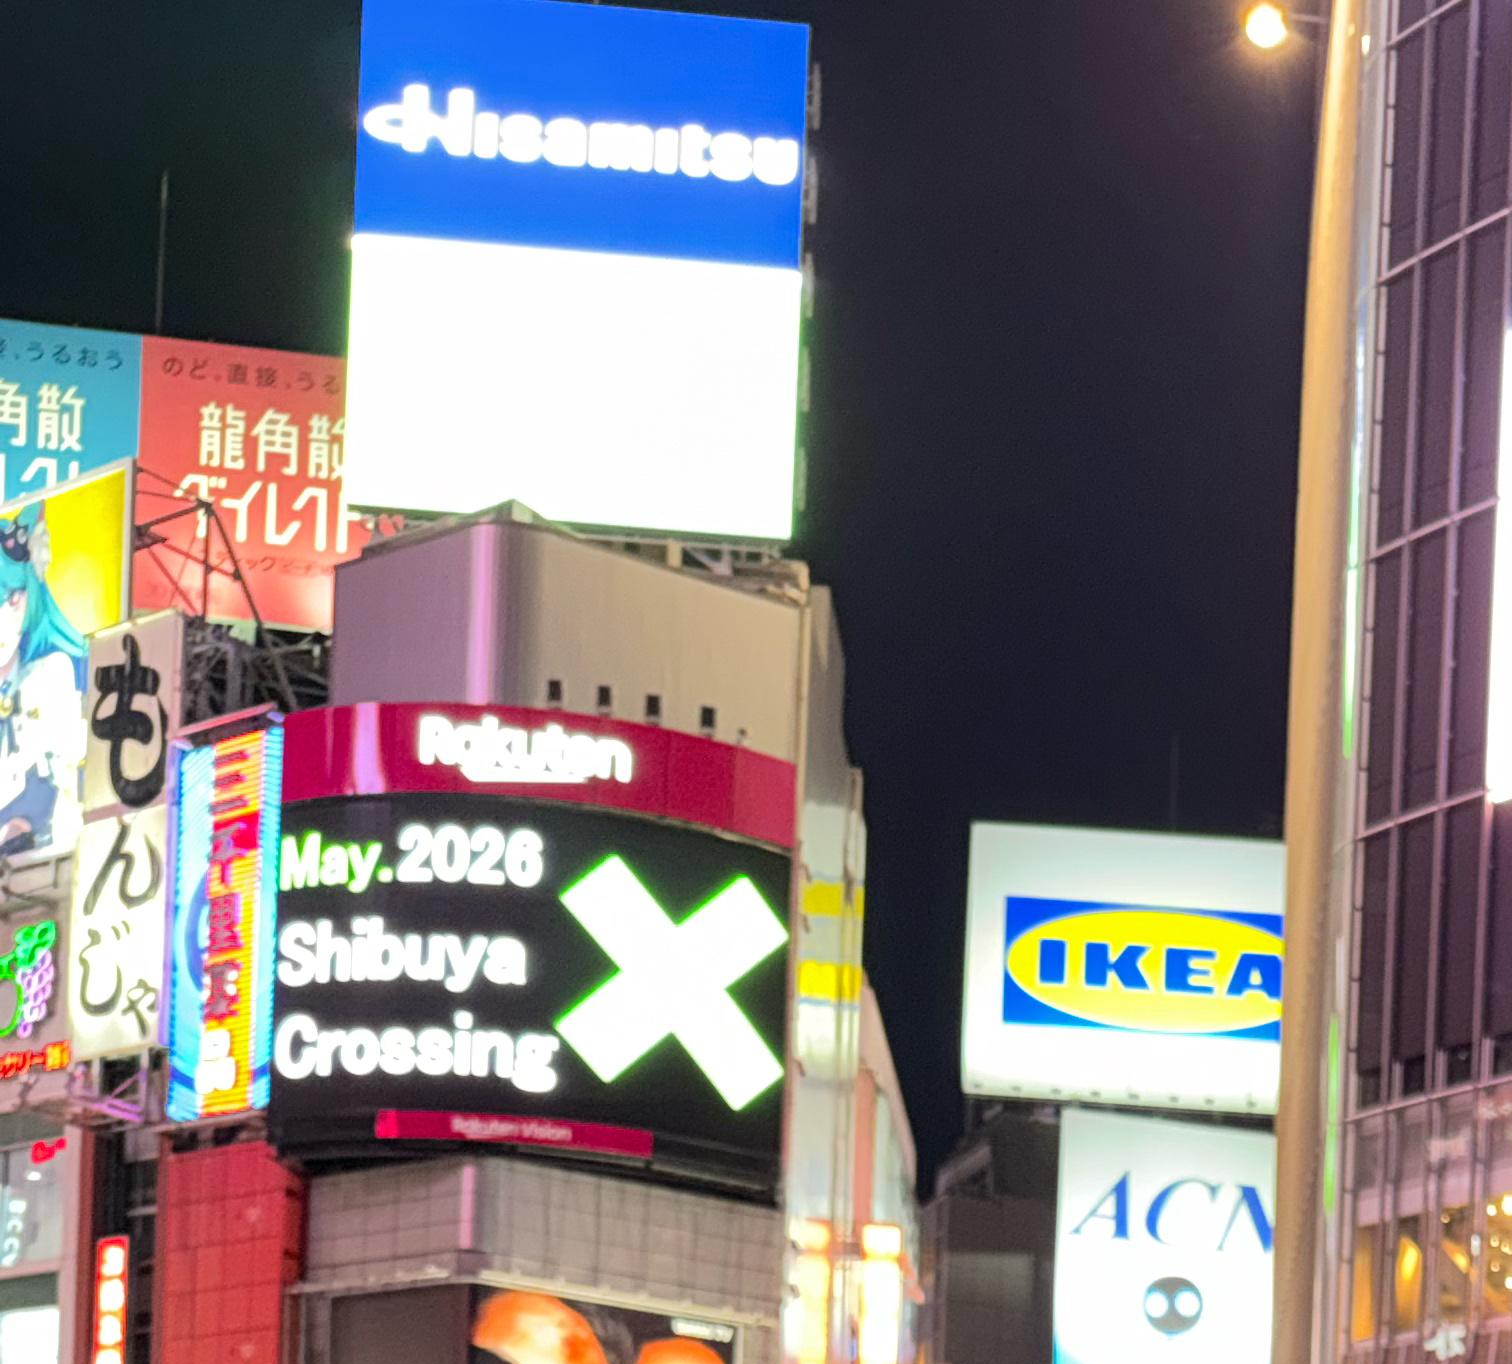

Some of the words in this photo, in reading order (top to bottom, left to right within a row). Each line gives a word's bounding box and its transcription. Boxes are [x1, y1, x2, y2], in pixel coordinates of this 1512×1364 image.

[363, 84, 798, 185] Hisamitsu
[0, 339, 124, 371] 、うるおう
[199, 401, 346, 480] 龍角散
[174, 474, 361, 553] ダイレクト
[418, 715, 633, 783] Rakuten
[79, 634, 168, 1038] もんじゃ
[277, 915, 528, 992] Shibuya
[1038, 937, 1282, 1001] IKEA
[273, 1010, 560, 1092] Crossing
